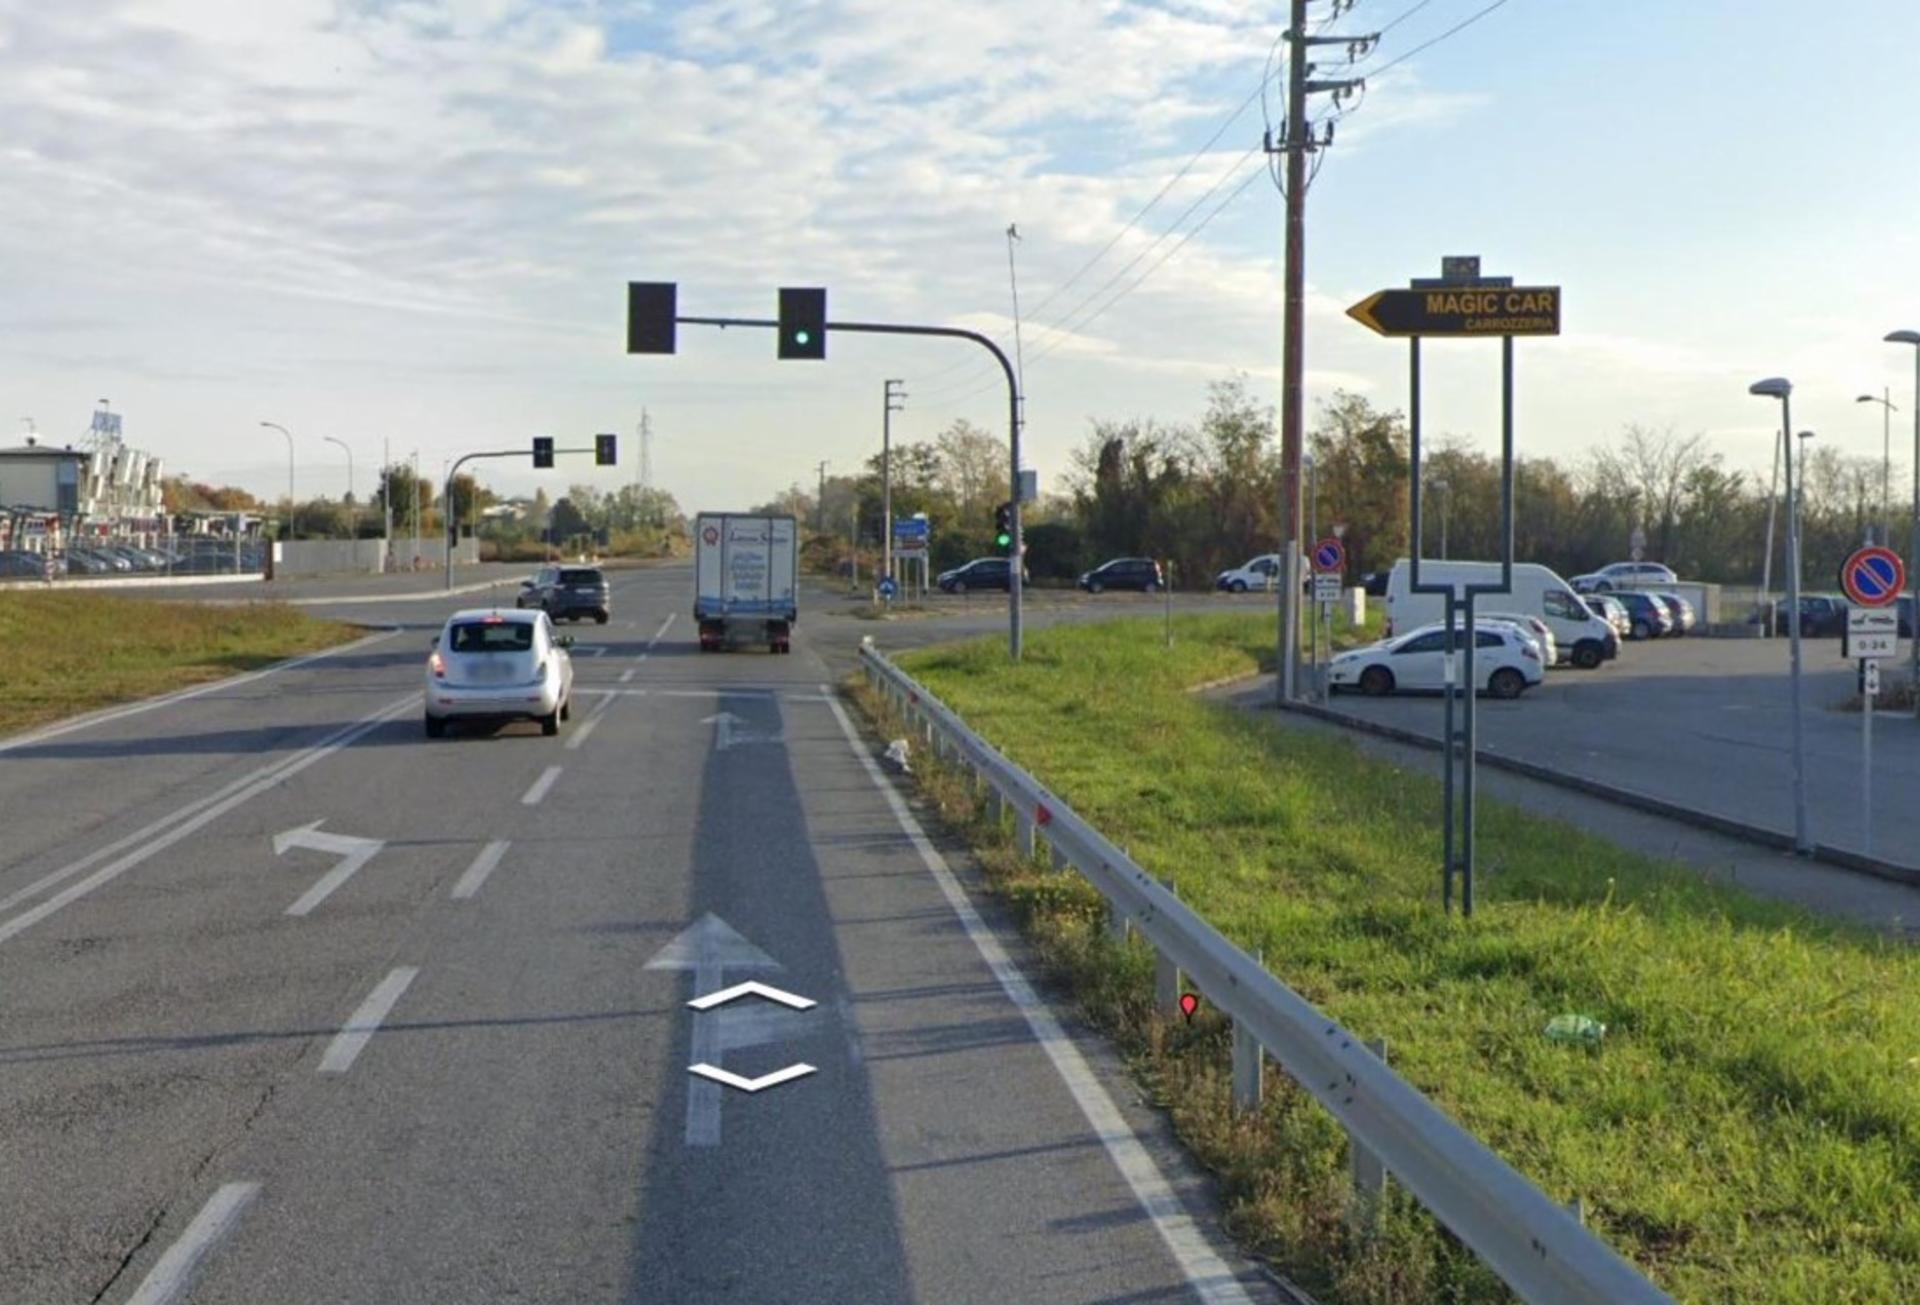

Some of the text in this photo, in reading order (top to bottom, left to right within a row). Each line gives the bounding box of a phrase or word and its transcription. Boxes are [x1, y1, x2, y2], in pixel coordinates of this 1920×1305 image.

[1426, 293, 1553, 313] MAGIC CAR
[1465, 317, 1553, 330] CARROZZERIA
